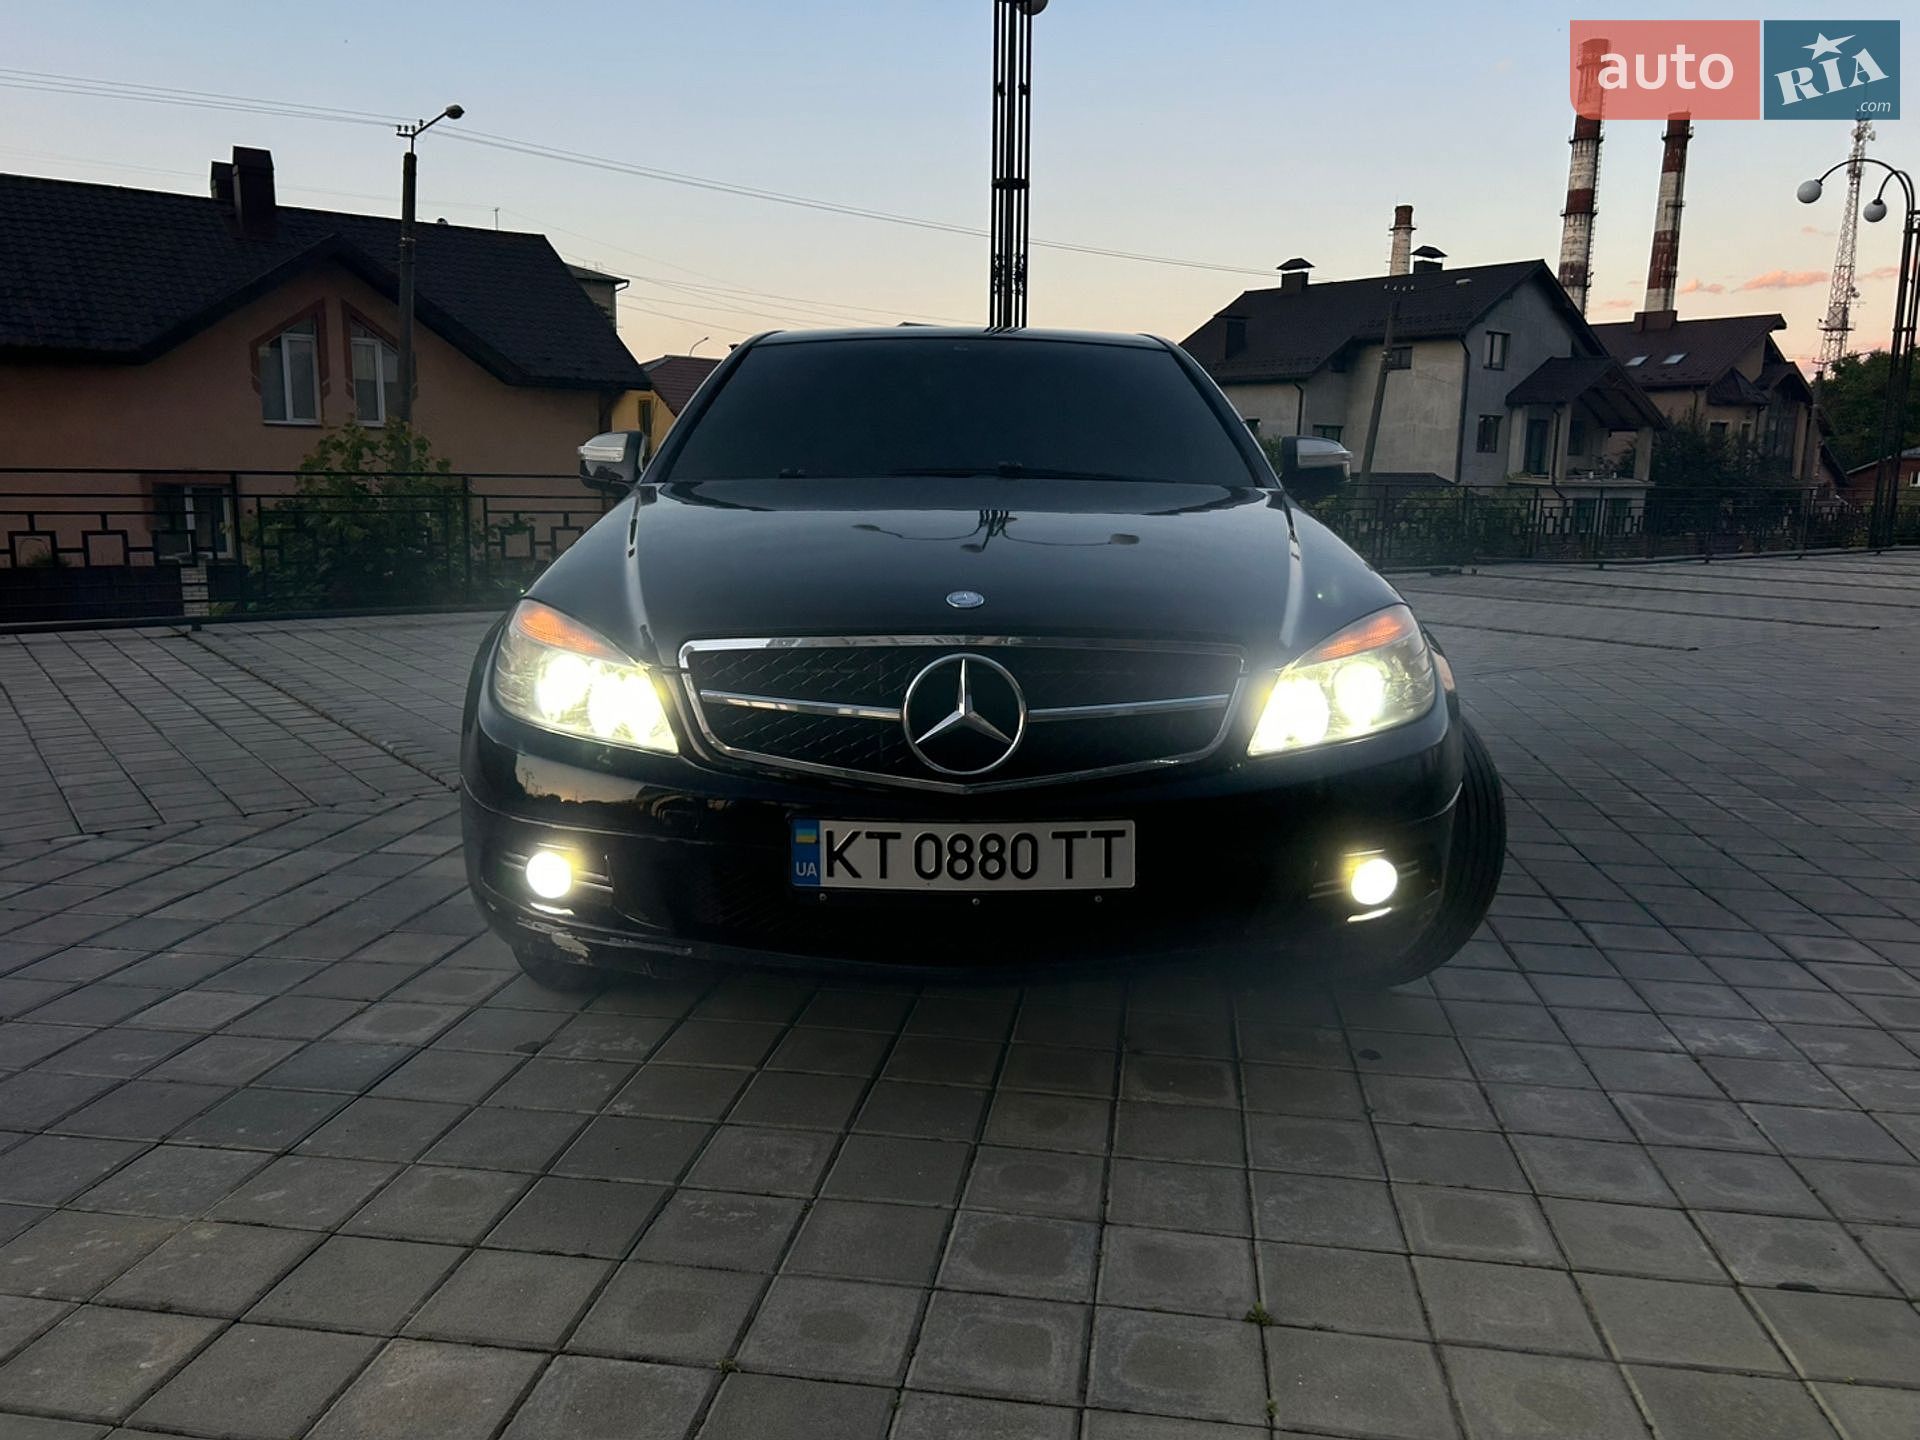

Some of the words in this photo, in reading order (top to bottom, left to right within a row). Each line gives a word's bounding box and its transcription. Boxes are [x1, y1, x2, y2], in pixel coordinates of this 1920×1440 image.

[796, 862, 817, 877] UA
[825, 830, 901, 879] KT
[914, 831, 1038, 880] 0880
[1051, 829, 1126, 879] TT
